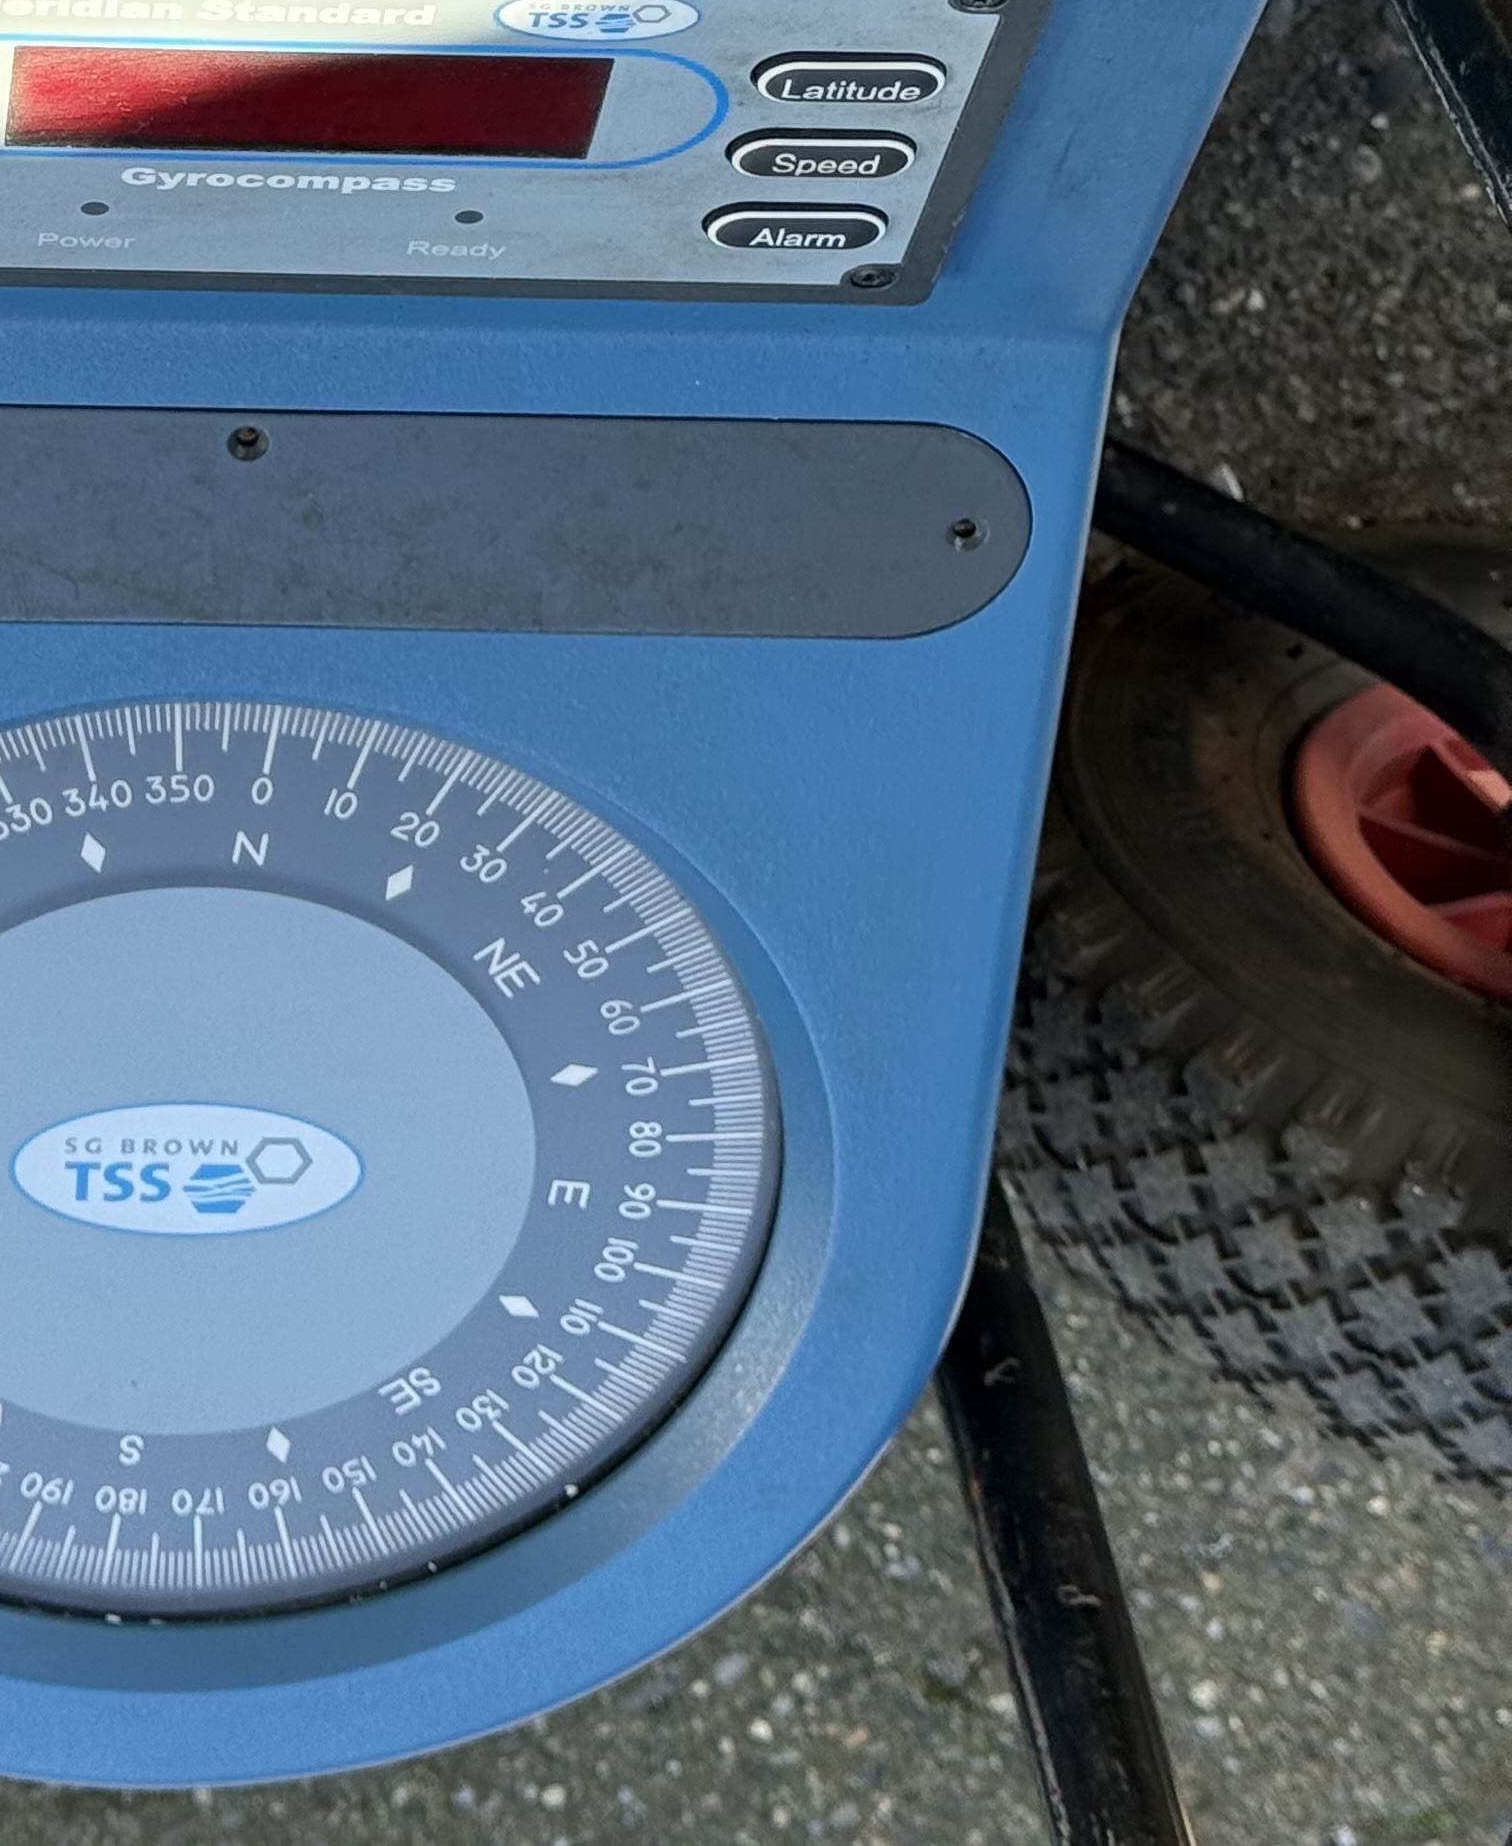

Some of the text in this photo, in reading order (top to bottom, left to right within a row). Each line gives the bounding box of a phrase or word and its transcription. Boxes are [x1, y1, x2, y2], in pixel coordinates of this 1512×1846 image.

[529, 12, 588, 28] TSS
[561, 4, 630, 12] BROWN
[781, 79, 921, 101] Latitude
[120, 166, 457, 195] Gyrocompass
[772, 153, 881, 176] Speed
[37, 232, 136, 249] Power
[407, 240, 508, 260] Ready
[749, 228, 846, 247] Alarm
[62, 779, 133, 818] 340
[143, 772, 216, 805] 350
[250, 776, 273, 805] 0
[323, 788, 358, 819] 10
[390, 811, 441, 848] 20
[232, 830, 270, 867] N
[459, 844, 508, 884] 30
[520, 891, 564, 928] 40
[473, 937, 541, 998] NE
[563, 939, 609, 980] 50
[599, 999, 641, 1035] 60
[621, 1056, 659, 1096] 70
[64, 1137, 239, 1156] SG BROWN
[628, 1119, 662, 1159] 80
[64, 1161, 172, 1203] TSS
[547, 1177, 591, 1209] E
[618, 1181, 656, 1220] 90
[593, 1236, 639, 1283] 100
[559, 1297, 604, 1335] 110
[511, 1343, 564, 1390] 120
[378, 1365, 442, 1415] SE
[455, 1389, 509, 1432] 130
[119, 1433, 145, 1466] S
[391, 1425, 447, 1467] 140
[20, 1470, 74, 1505] 190
[248, 1476, 303, 1509] 160
[321, 1455, 377, 1494] 150
[94, 1484, 147, 1515] 180
[171, 1486, 225, 1516] 170
